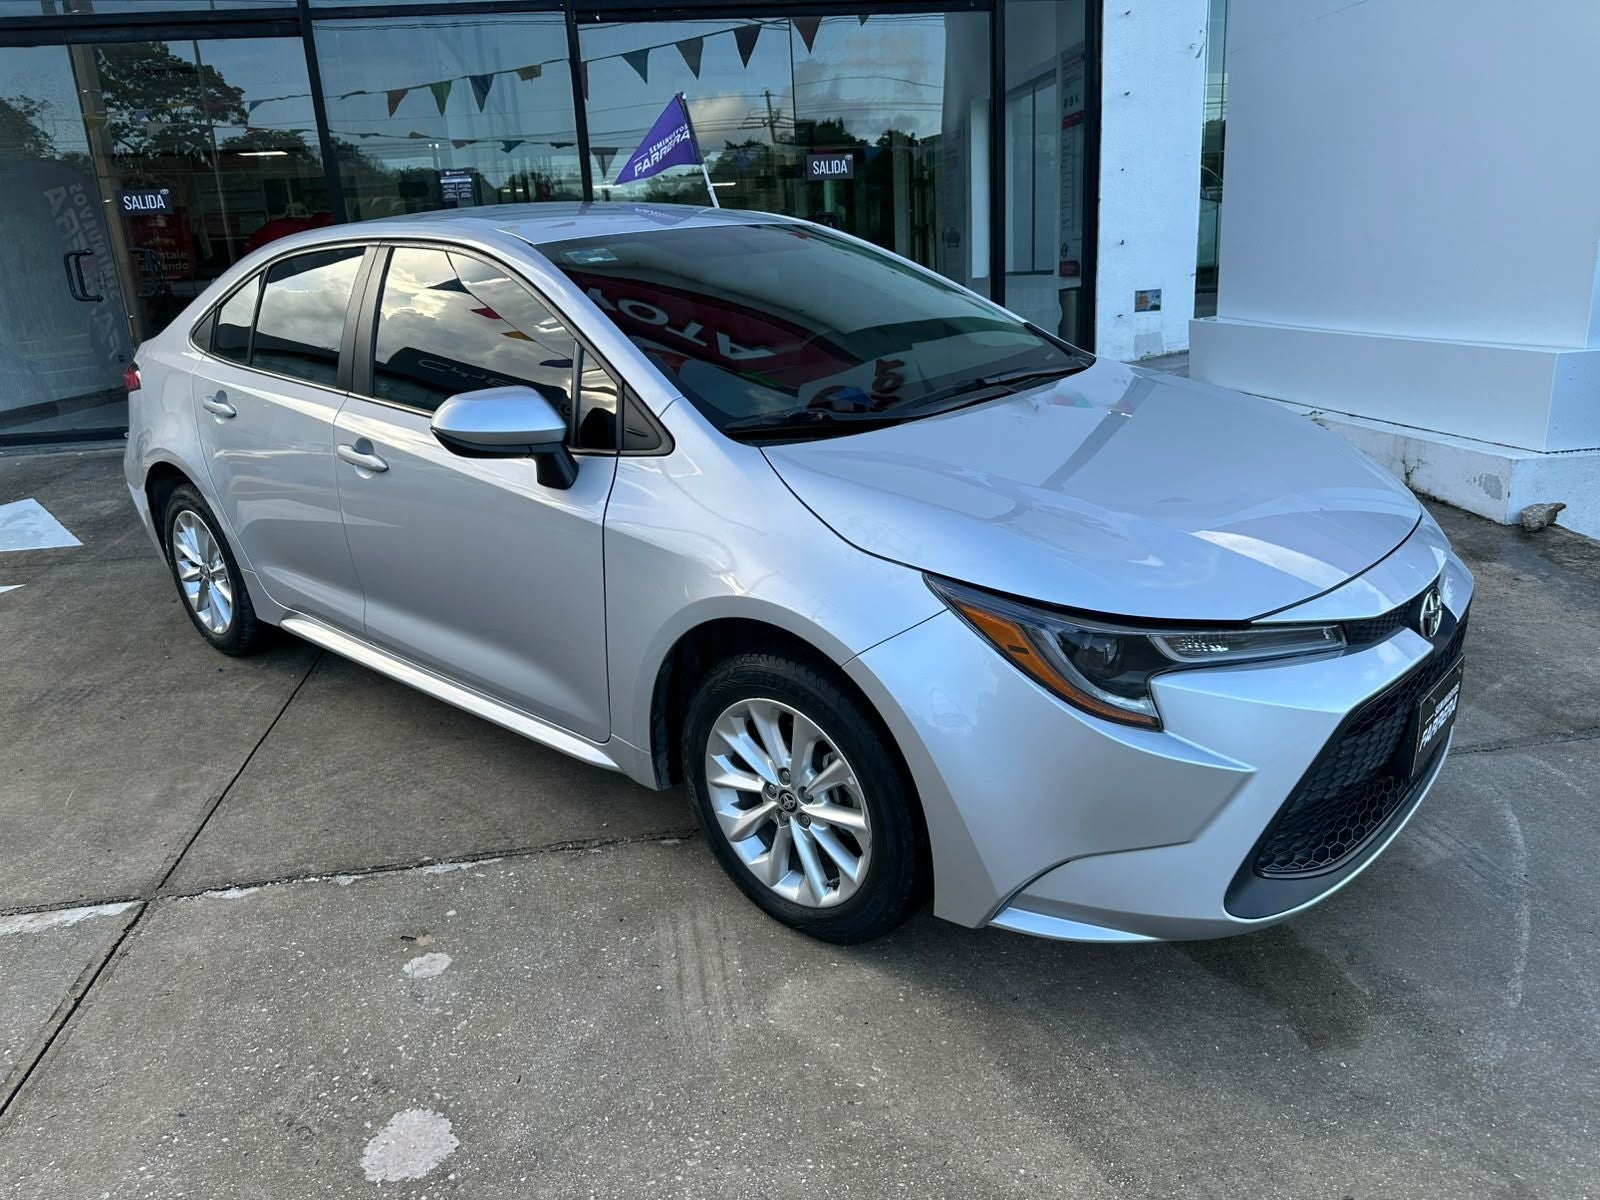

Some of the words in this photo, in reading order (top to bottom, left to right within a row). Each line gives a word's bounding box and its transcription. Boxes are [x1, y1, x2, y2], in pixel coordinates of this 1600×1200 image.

[648, 122, 688, 154] SEMINUEVOS
[634, 129, 691, 177] FARRERA
[812, 159, 848, 175] SALIDA
[123, 194, 166, 210] SALIDA
